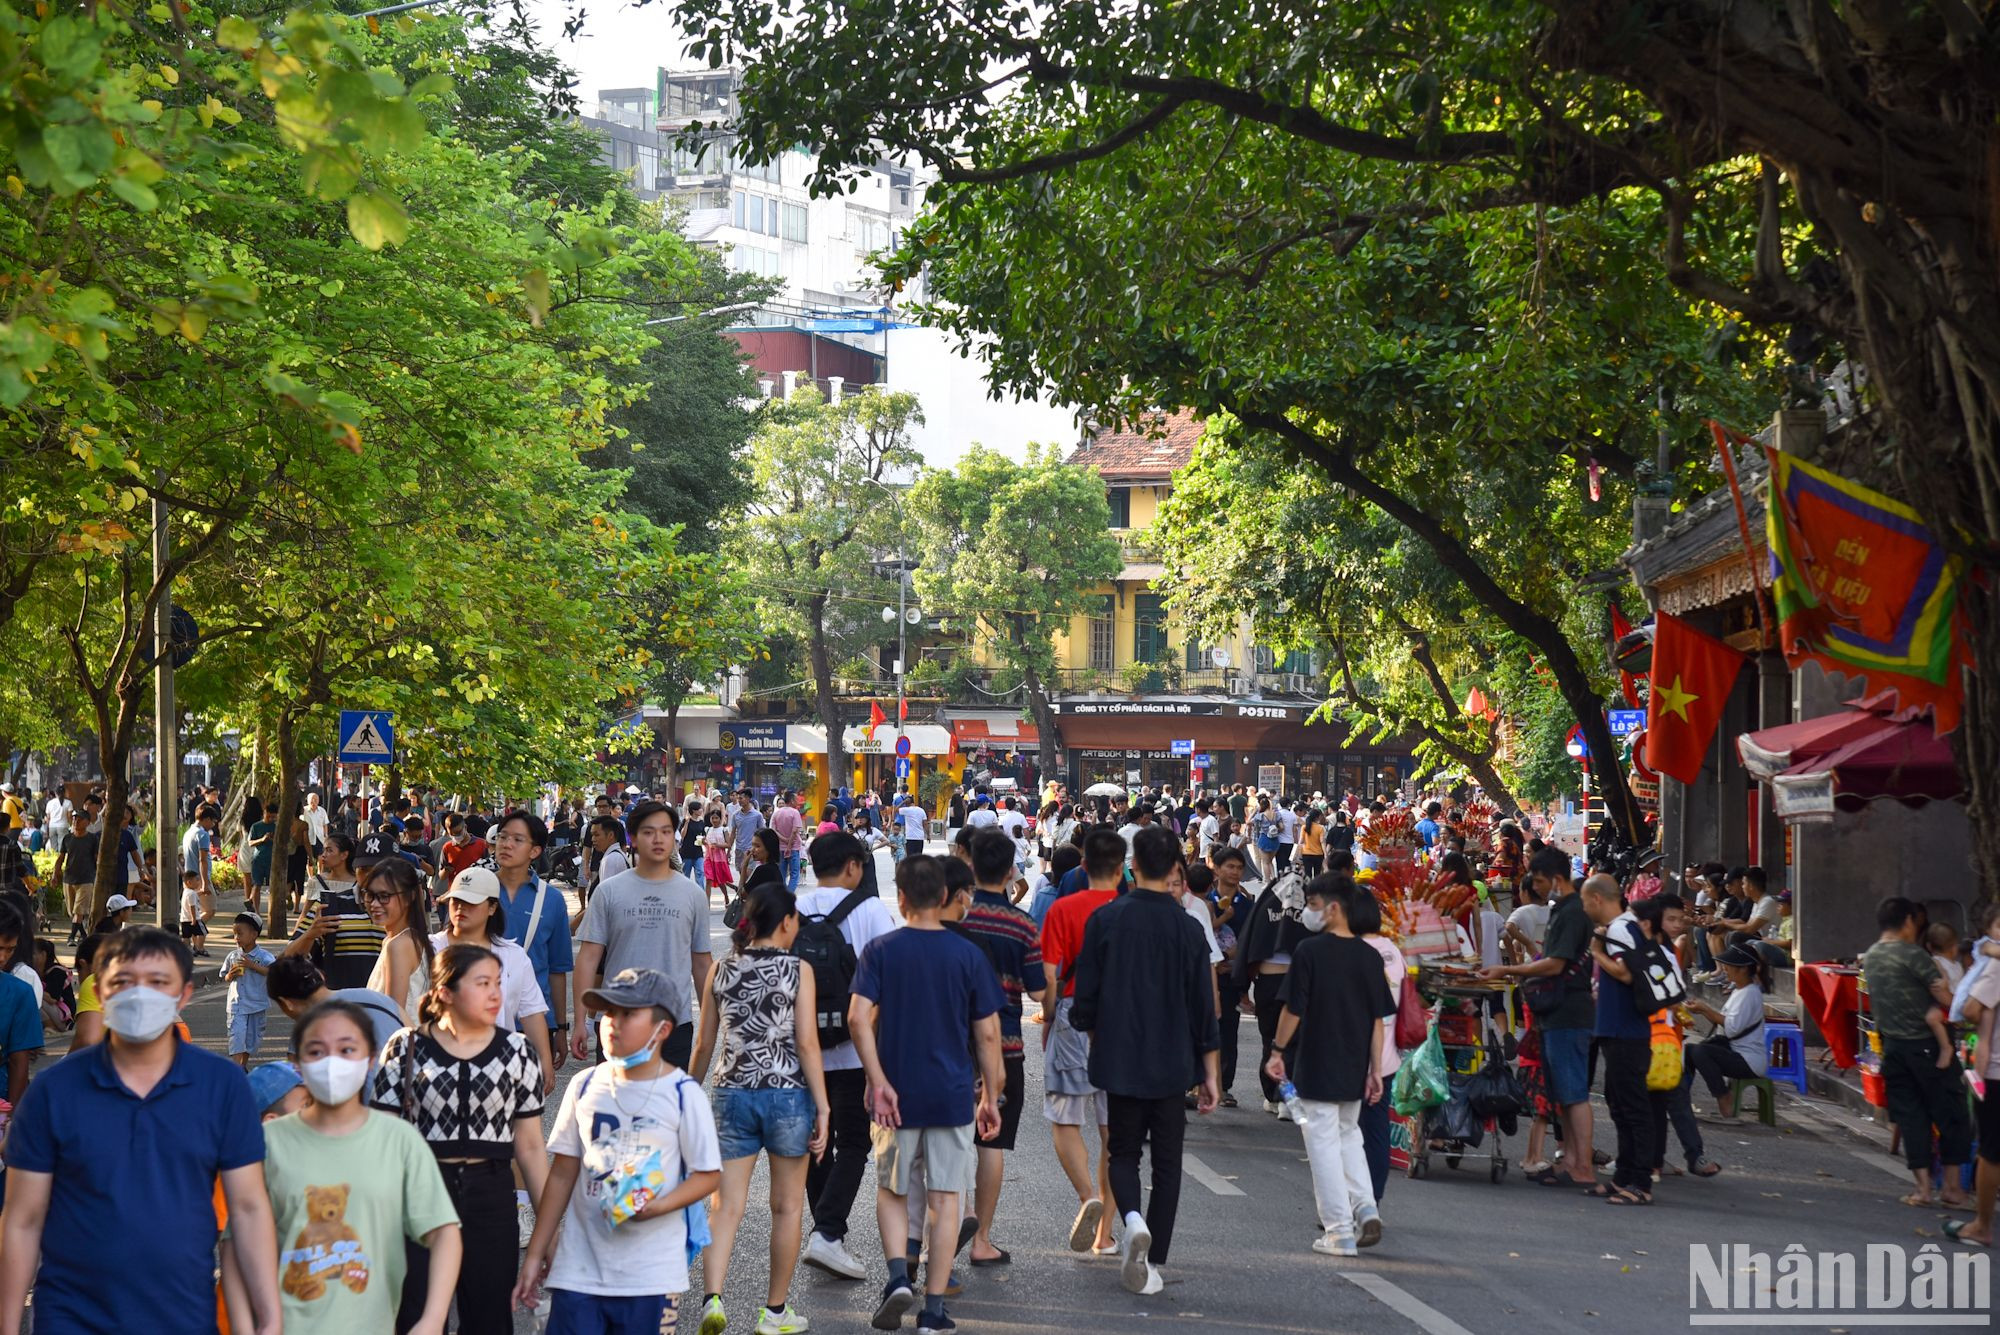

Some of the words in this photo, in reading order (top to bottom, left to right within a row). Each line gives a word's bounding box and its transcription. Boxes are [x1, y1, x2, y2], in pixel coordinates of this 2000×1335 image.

[1075, 704, 1097, 713] CÔNG
[1099, 705, 1108, 713] TY
[1143, 703, 1162, 713] SÁCH
[1164, 704, 1176, 713] HÀ
[1177, 704, 1191, 714] NỘI
[1239, 706, 1287, 718] POSTER
[1611, 720, 1626, 732] LÒ
[738, 737, 762, 749] Thanh
[1081, 750, 1122, 758] ARTBOOK
[1126, 750, 1141, 759] 53
[623, 907, 636, 918] THE
[639, 907, 661, 916] NORTH
[663, 907, 680, 919] FACE
